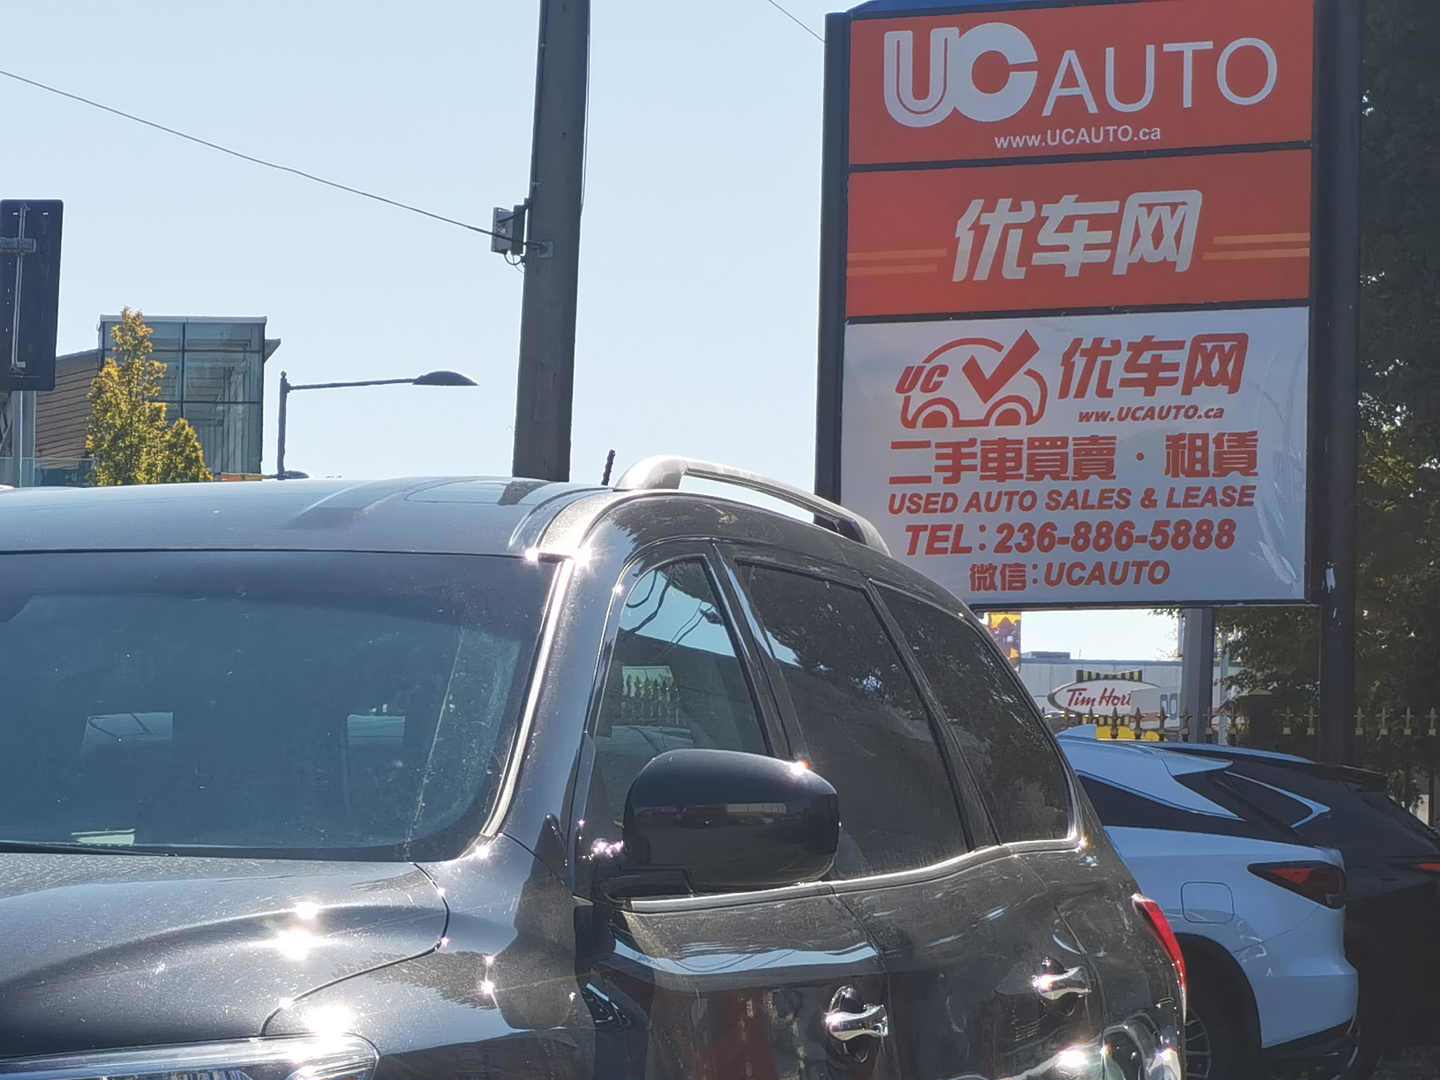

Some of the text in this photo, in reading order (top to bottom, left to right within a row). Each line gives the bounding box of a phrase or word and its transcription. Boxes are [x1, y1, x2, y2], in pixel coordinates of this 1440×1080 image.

[994, 125, 1161, 149] www.UCAUTO.ca
[952, 189, 1203, 282] 优车网
[895, 364, 950, 394] UC
[1057, 332, 1249, 400] 优车网
[888, 435, 1117, 485] 二手車買賣
[1164, 430, 1259, 478] 租賃
[888, 485, 1257, 515] USED AUTO SALES & LEASE
[1067, 687, 1096, 708] Tim
